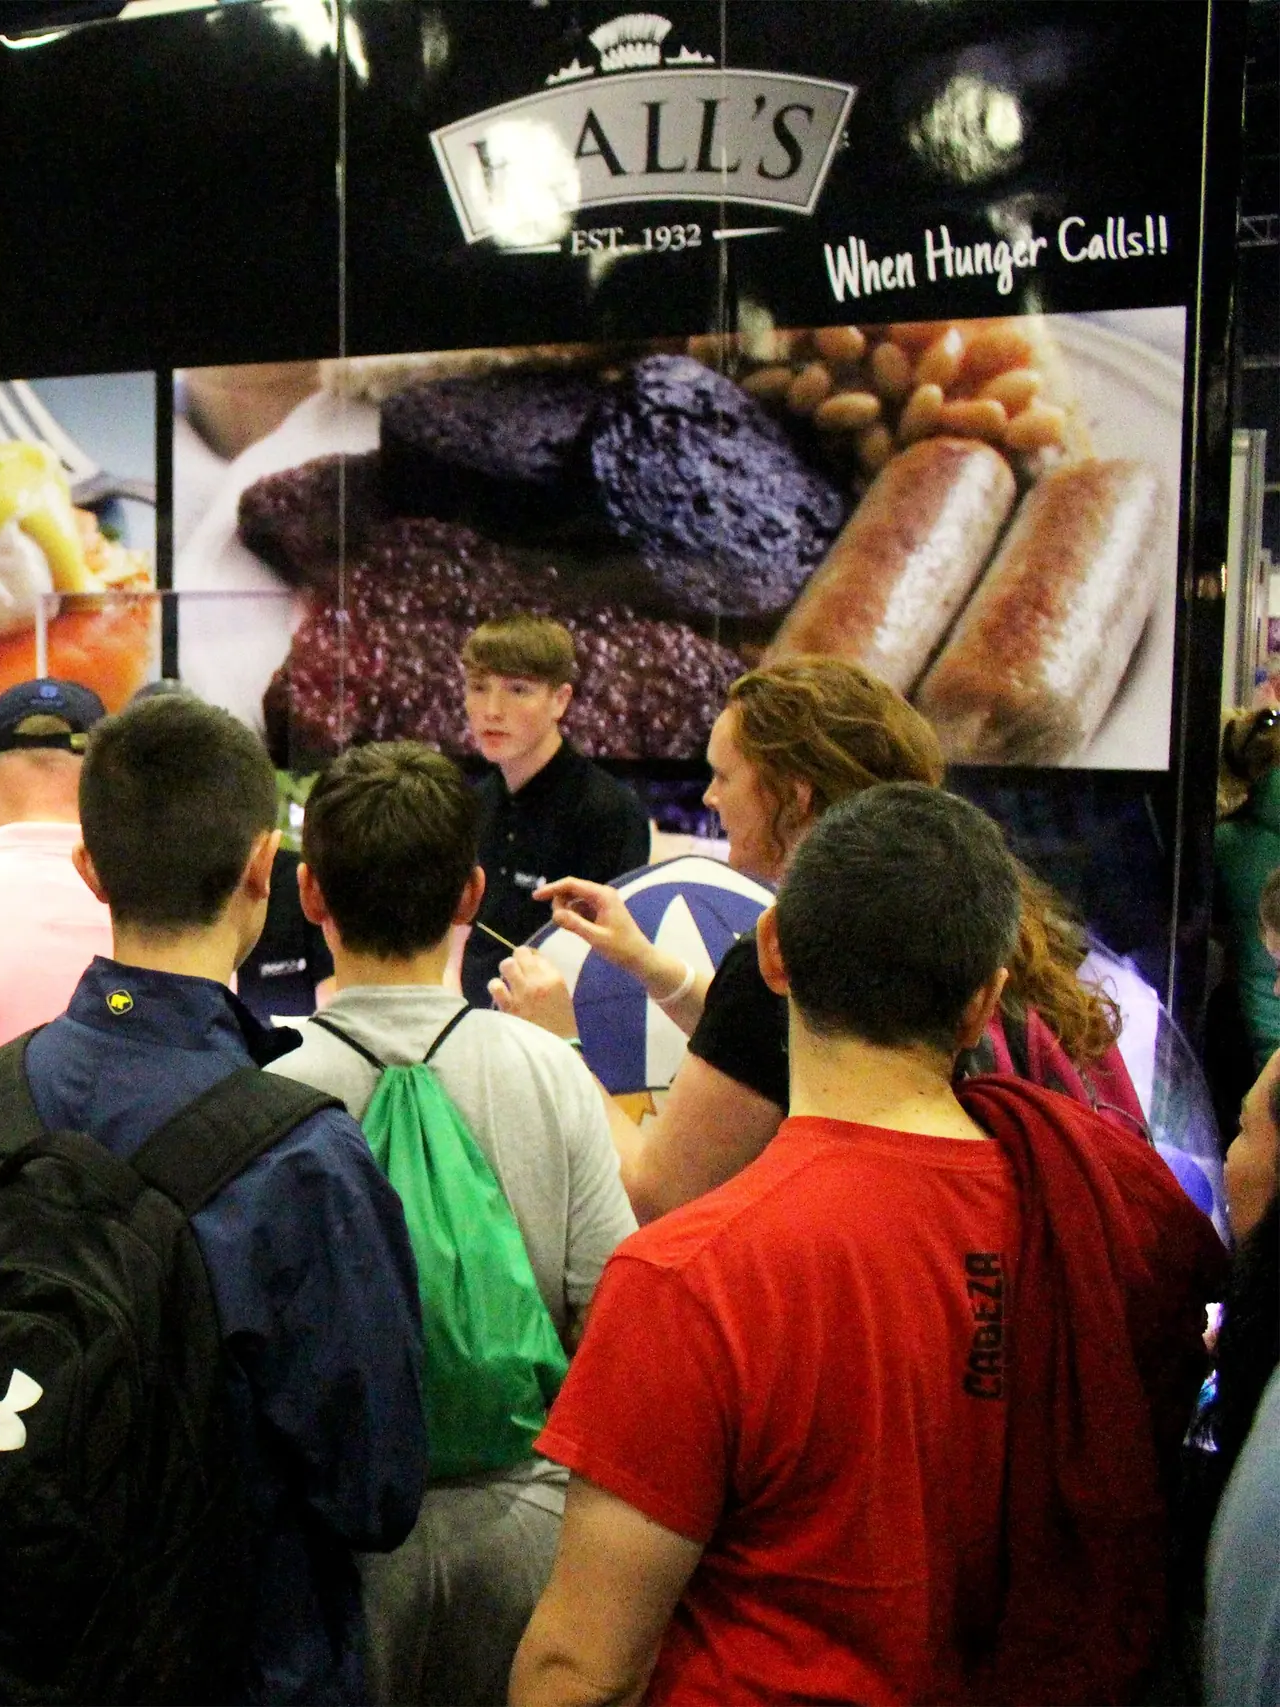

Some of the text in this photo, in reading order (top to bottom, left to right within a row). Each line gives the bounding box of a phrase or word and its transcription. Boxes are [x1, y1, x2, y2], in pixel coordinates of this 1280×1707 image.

[468, 95, 815, 204] ALL'S
[641, 222, 702, 252] 1932
[824, 214, 1168, 302] When Hunger Calls!!
